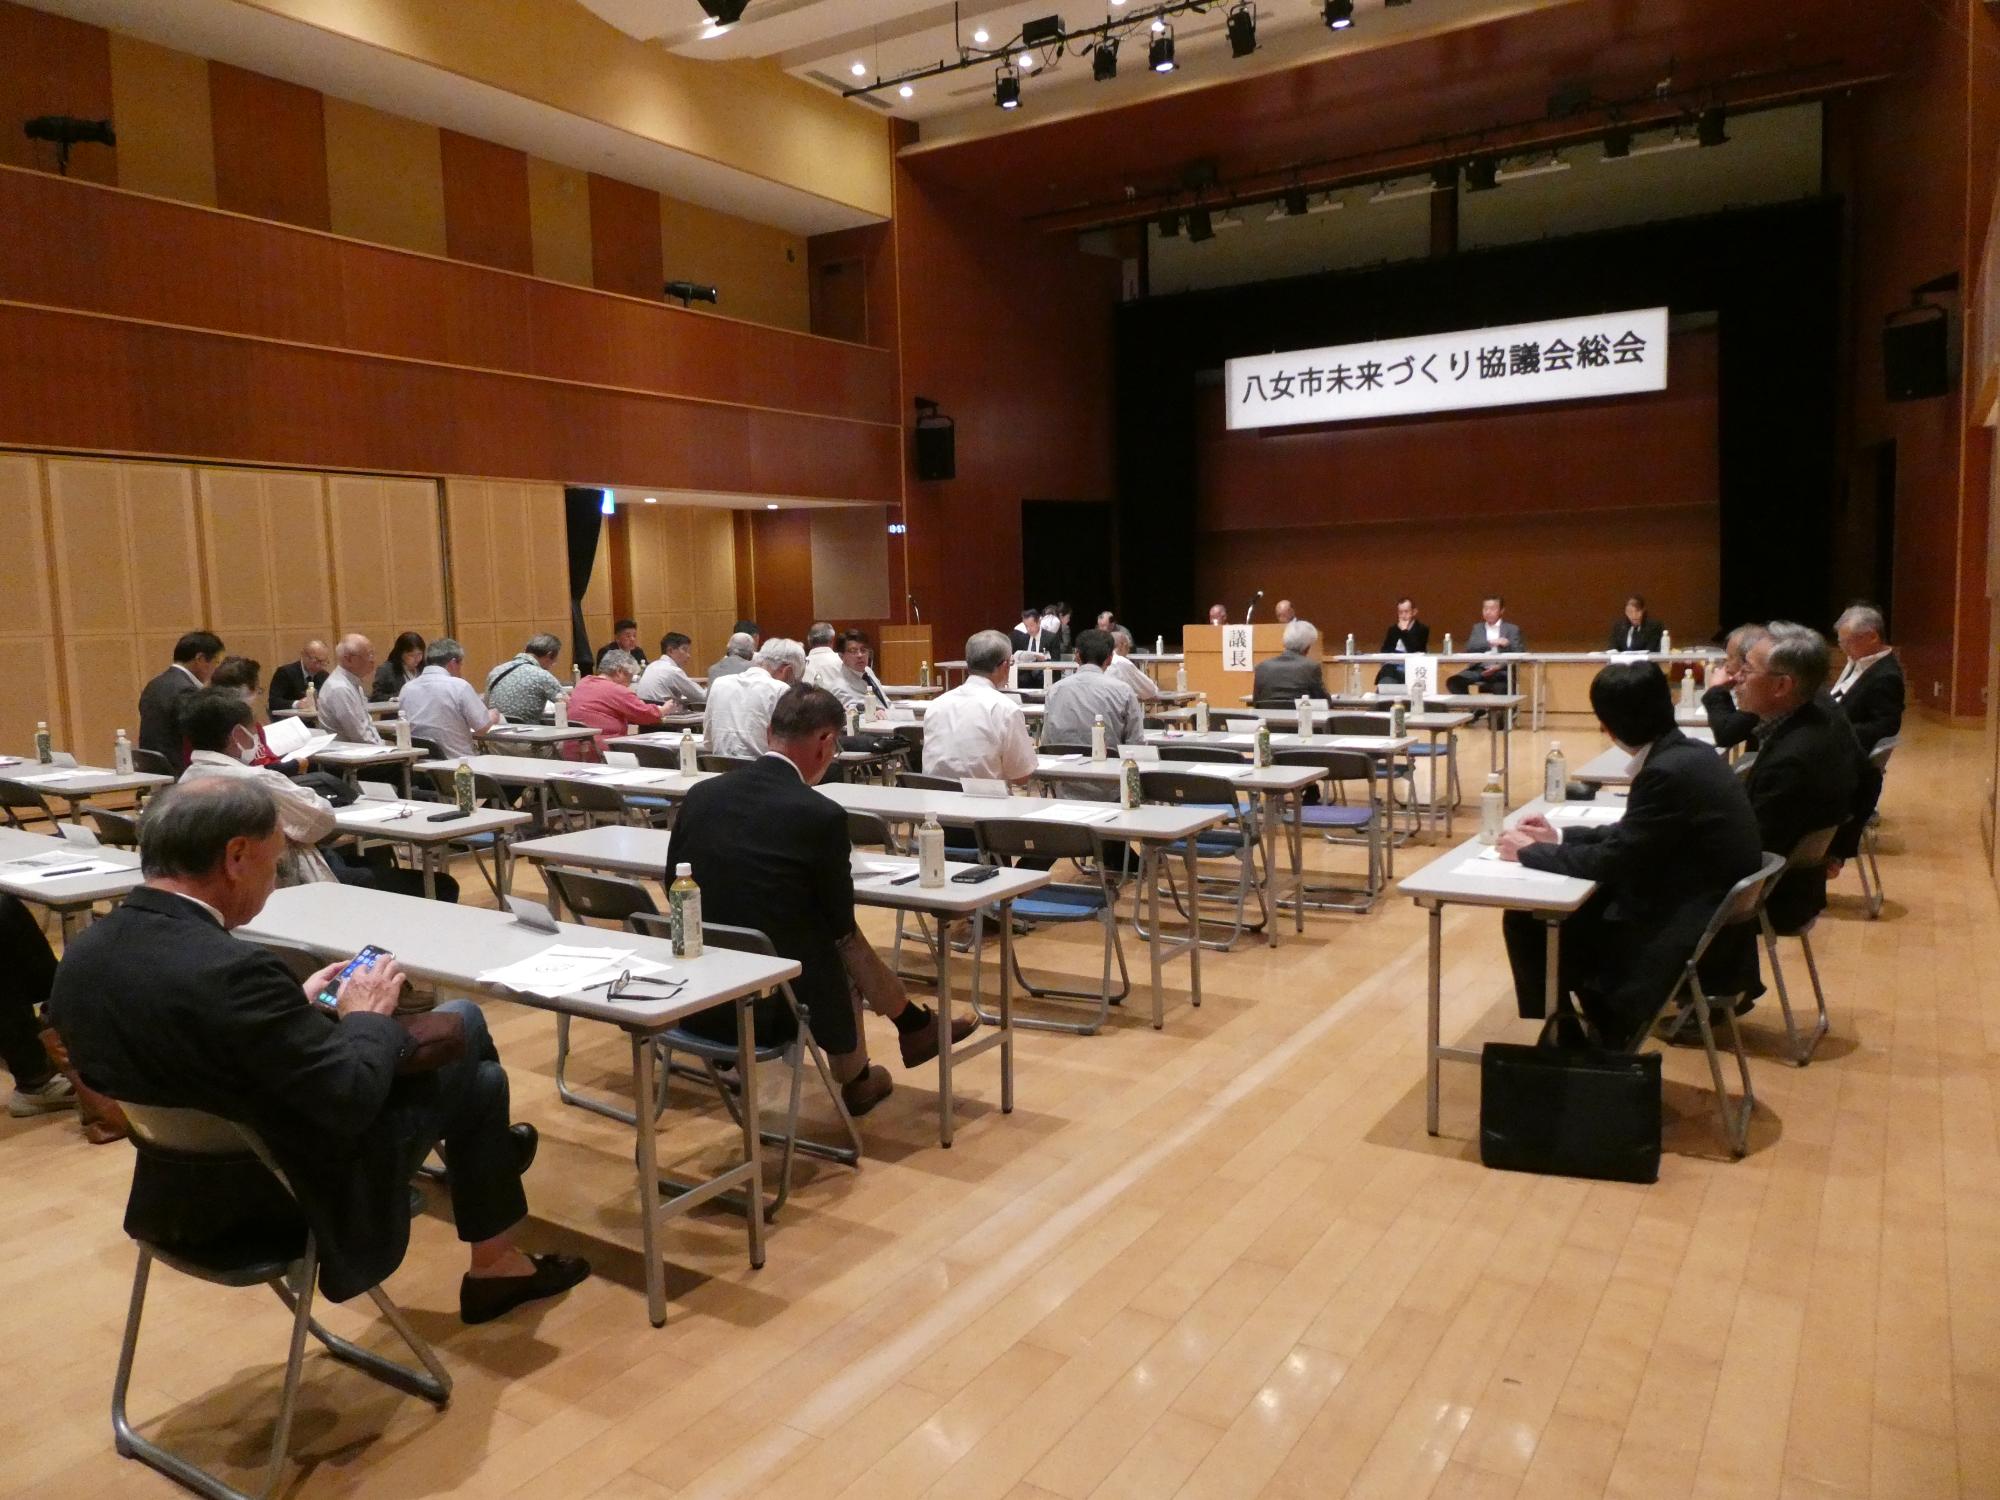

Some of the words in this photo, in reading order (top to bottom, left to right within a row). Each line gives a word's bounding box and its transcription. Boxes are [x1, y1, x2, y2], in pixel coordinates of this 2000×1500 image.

[1242, 330, 1647, 404] 八女市未来づくり協議会総会
[1229, 628, 1247, 667] 議長
